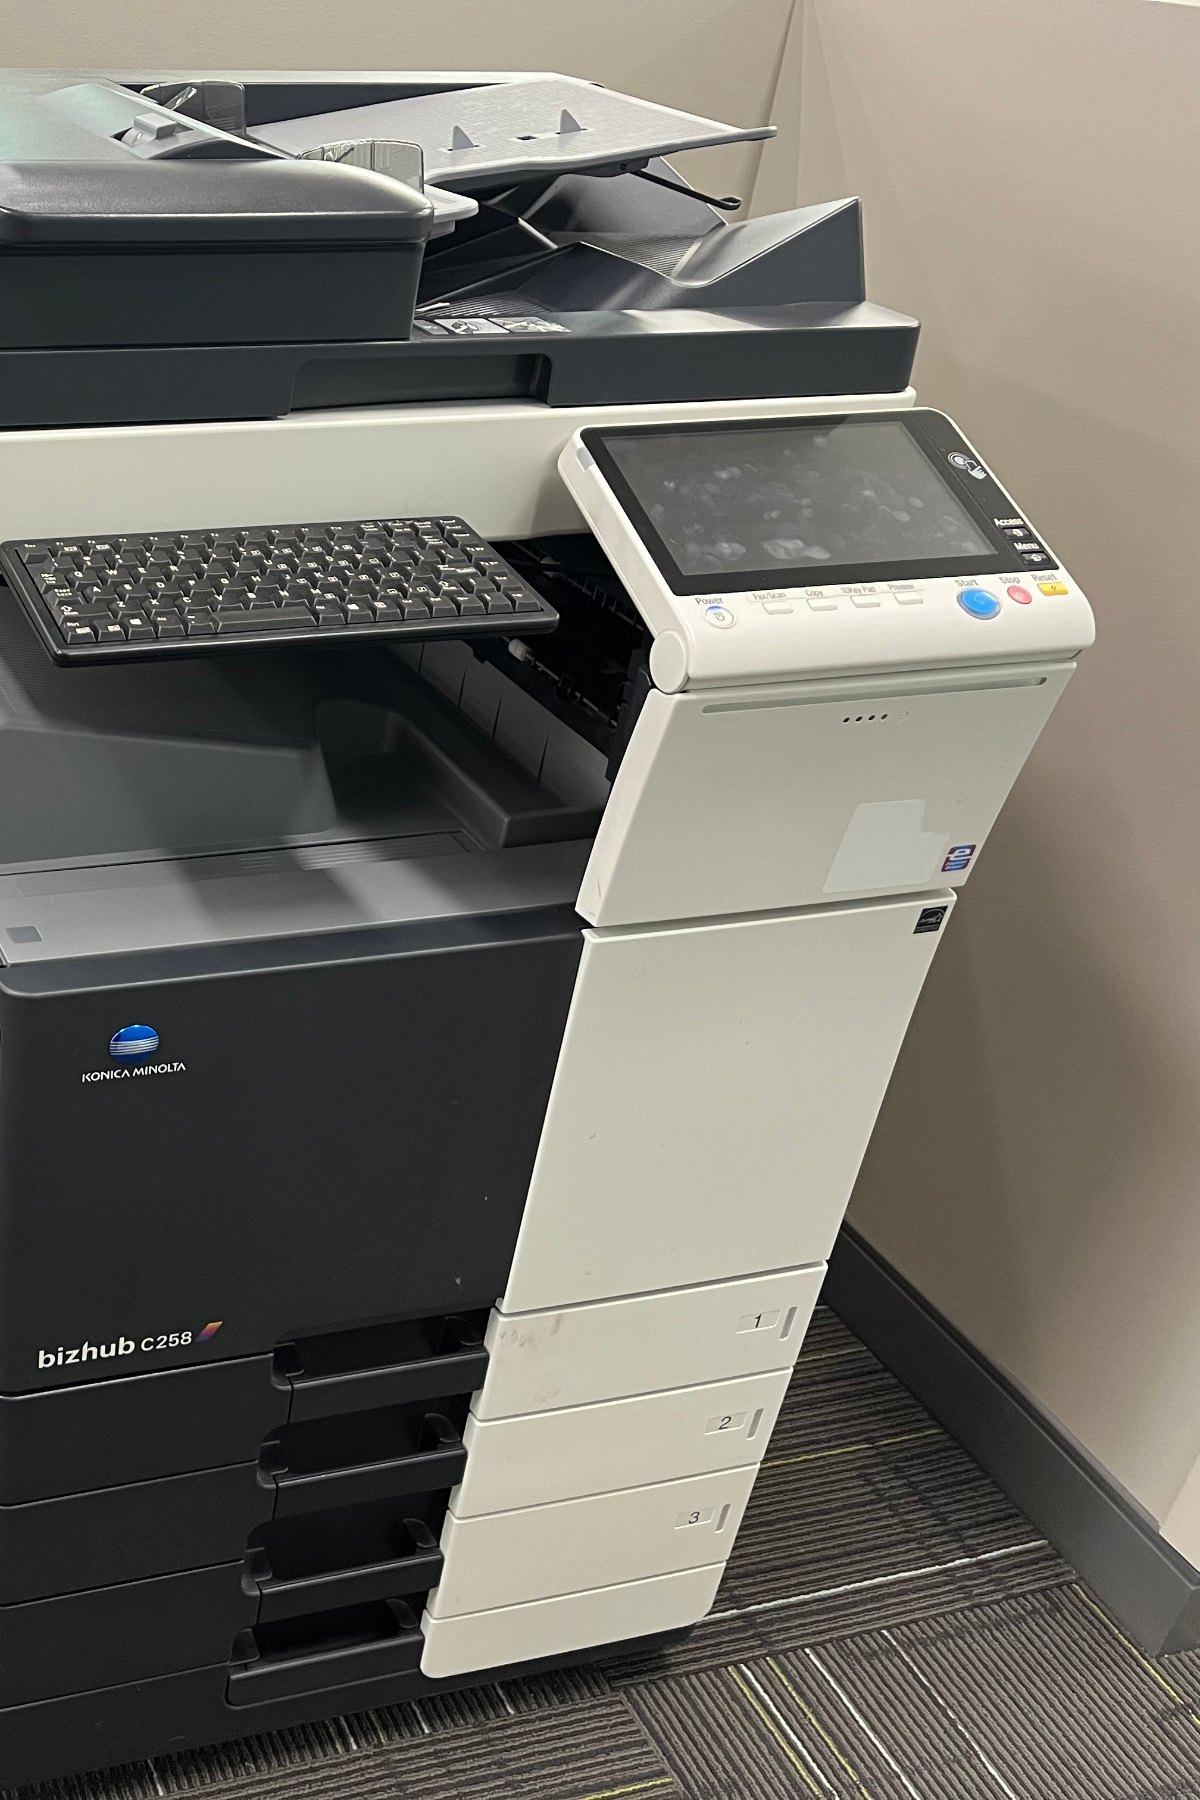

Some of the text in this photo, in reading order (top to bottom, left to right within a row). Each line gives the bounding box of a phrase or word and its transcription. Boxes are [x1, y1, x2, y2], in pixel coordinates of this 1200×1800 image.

[1013, 542, 1040, 551] Menu
[955, 578, 979, 587] Start
[999, 576, 1021, 585] Stop
[1031, 573, 1058, 582] Reset
[804, 589, 824, 598] Copy
[862, 585, 877, 594] Pad
[752, 590, 787, 601] Fax/Scan
[695, 596, 723, 606] Power
[81, 1062, 187, 1083] KONICA MINOLTA
[753, 1313, 763, 1329] 1
[37, 1331, 193, 1369] bizhub C258
[717, 1415, 732, 1430] 2
[688, 1511, 700, 1524] 3
